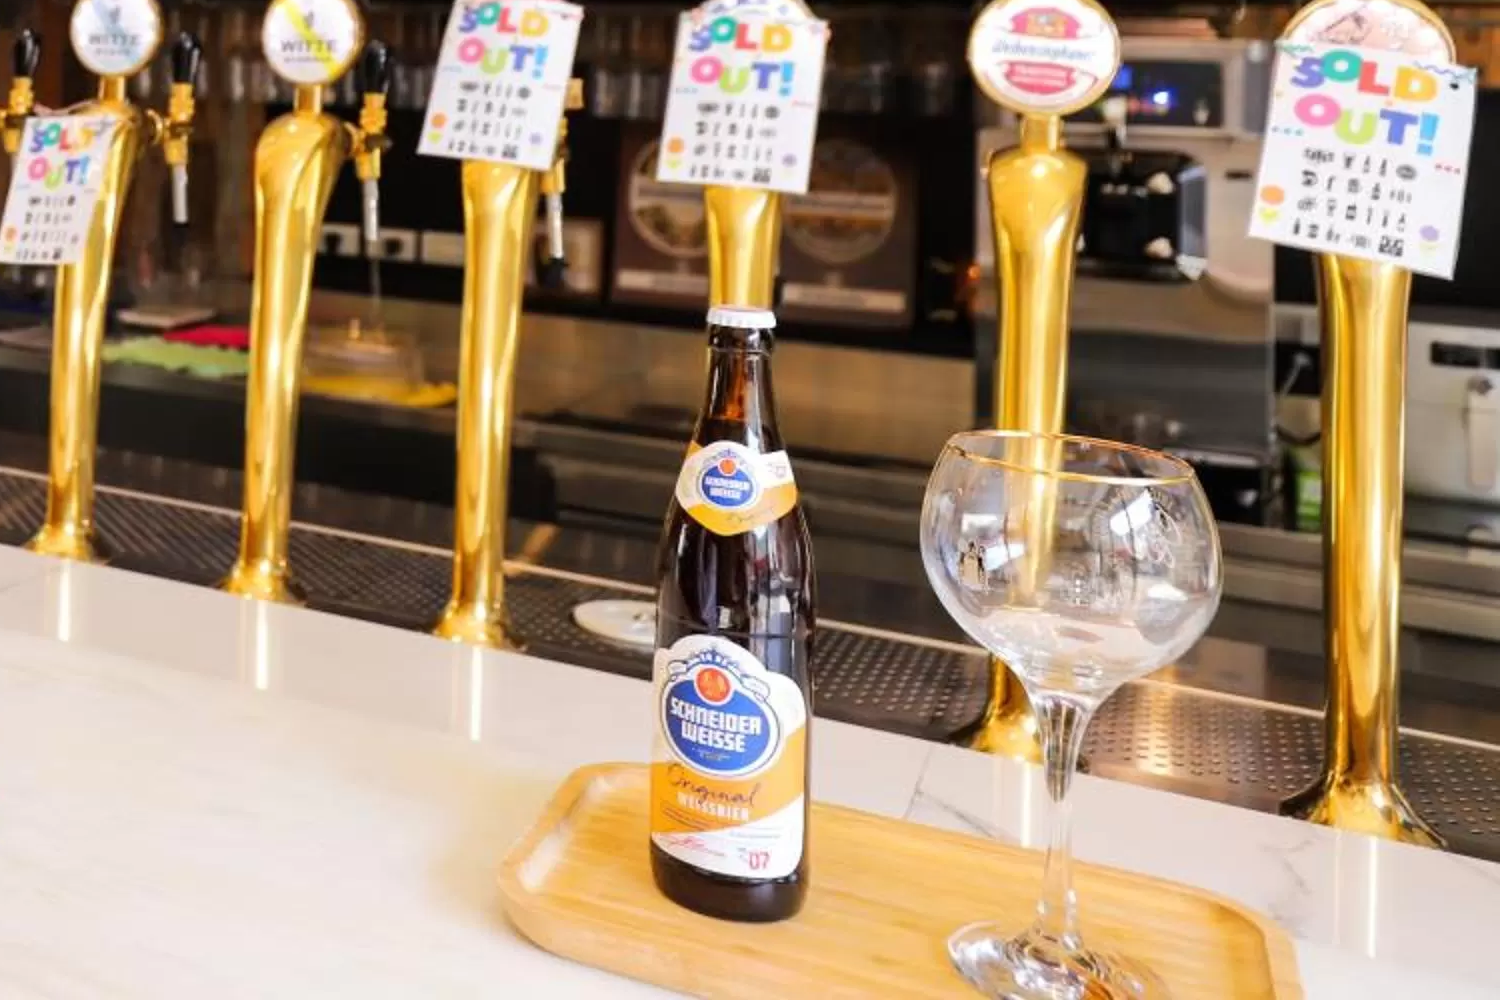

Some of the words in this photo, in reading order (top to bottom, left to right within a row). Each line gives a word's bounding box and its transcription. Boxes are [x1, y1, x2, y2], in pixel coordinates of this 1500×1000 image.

[457, 1, 549, 37] SOLD
[688, 16, 793, 52] SOLD
[457, 38, 548, 79] OUT!
[690, 56, 794, 97] OUT!
[1290, 49, 1439, 103] SOLD
[1294, 93, 1440, 156] OUT!
[27, 155, 90, 190] OUT!
[670, 696, 761, 736] SCHNEIDER
[681, 720, 746, 752] WEISSE
